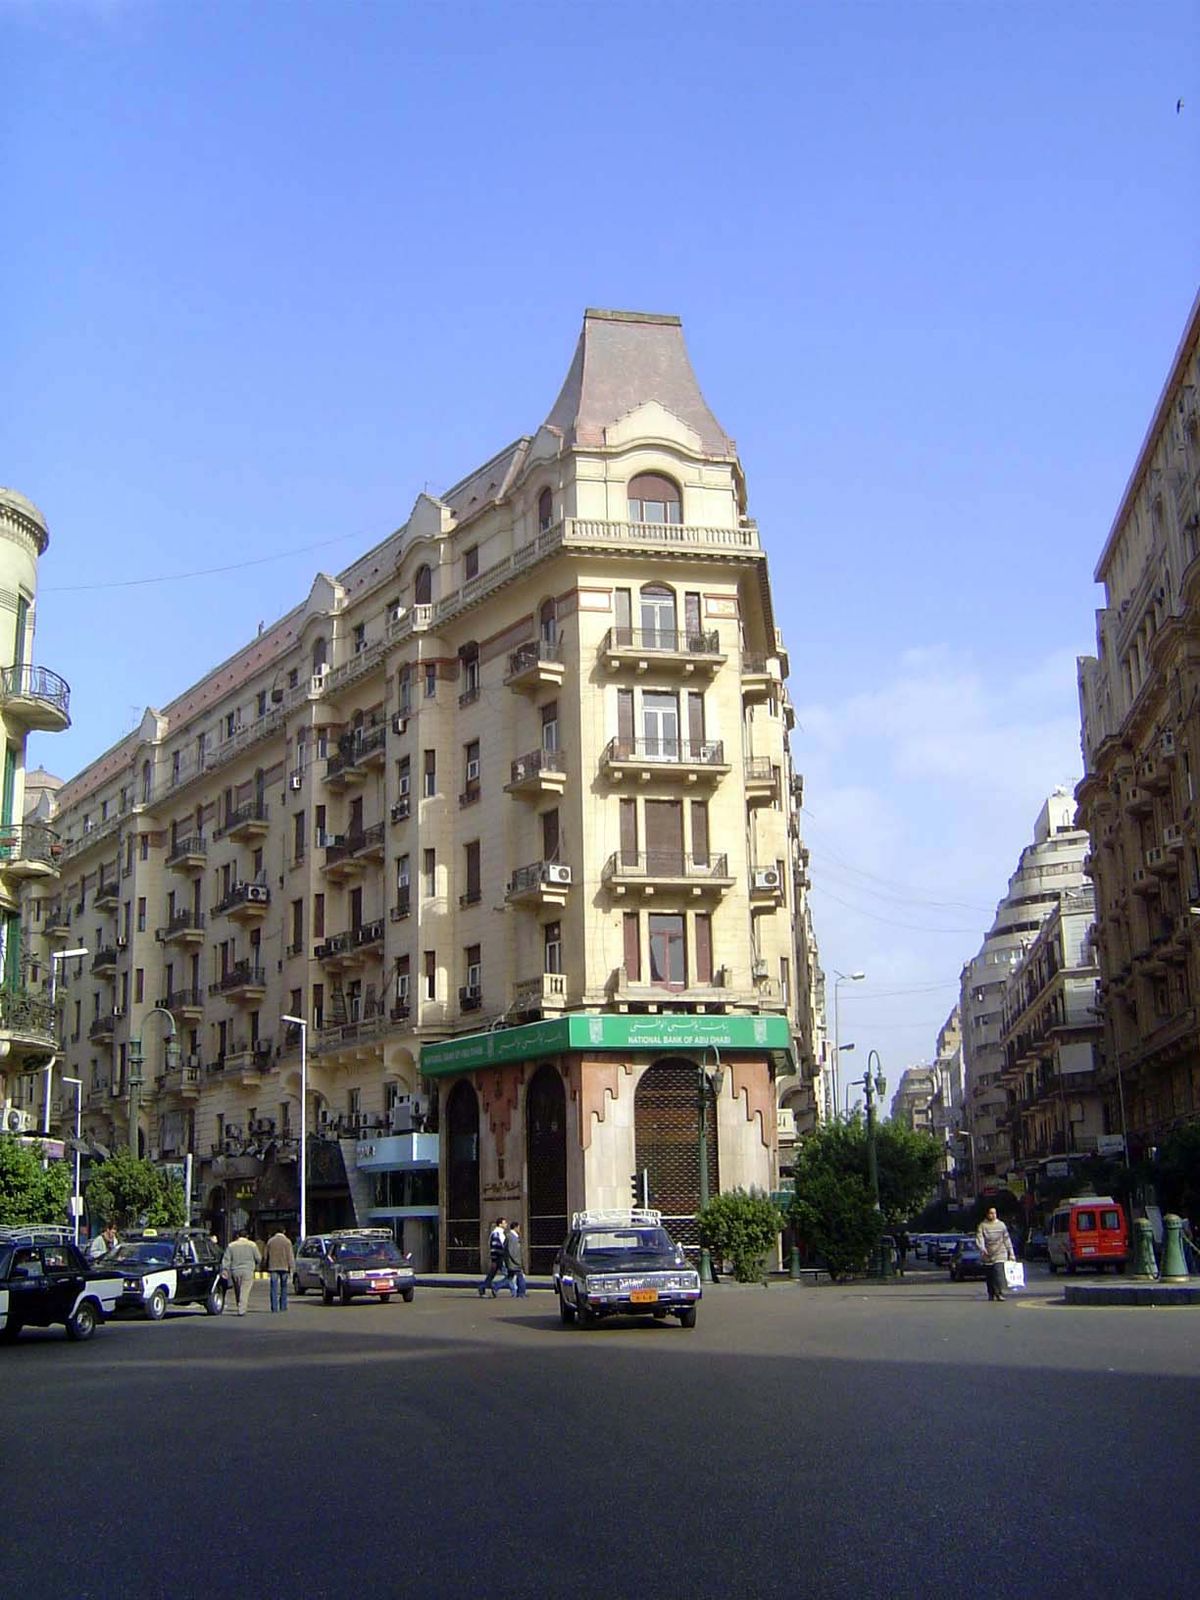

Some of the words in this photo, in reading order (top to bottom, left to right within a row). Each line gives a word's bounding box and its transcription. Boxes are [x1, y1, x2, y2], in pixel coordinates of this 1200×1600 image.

[628, 1036, 662, 1044] NATIONAL
[663, 1036, 682, 1044] BANK
[683, 1036, 693, 1044] OF
[694, 1036, 709, 1044] ABU
[710, 1036, 731, 1044] DHABI
